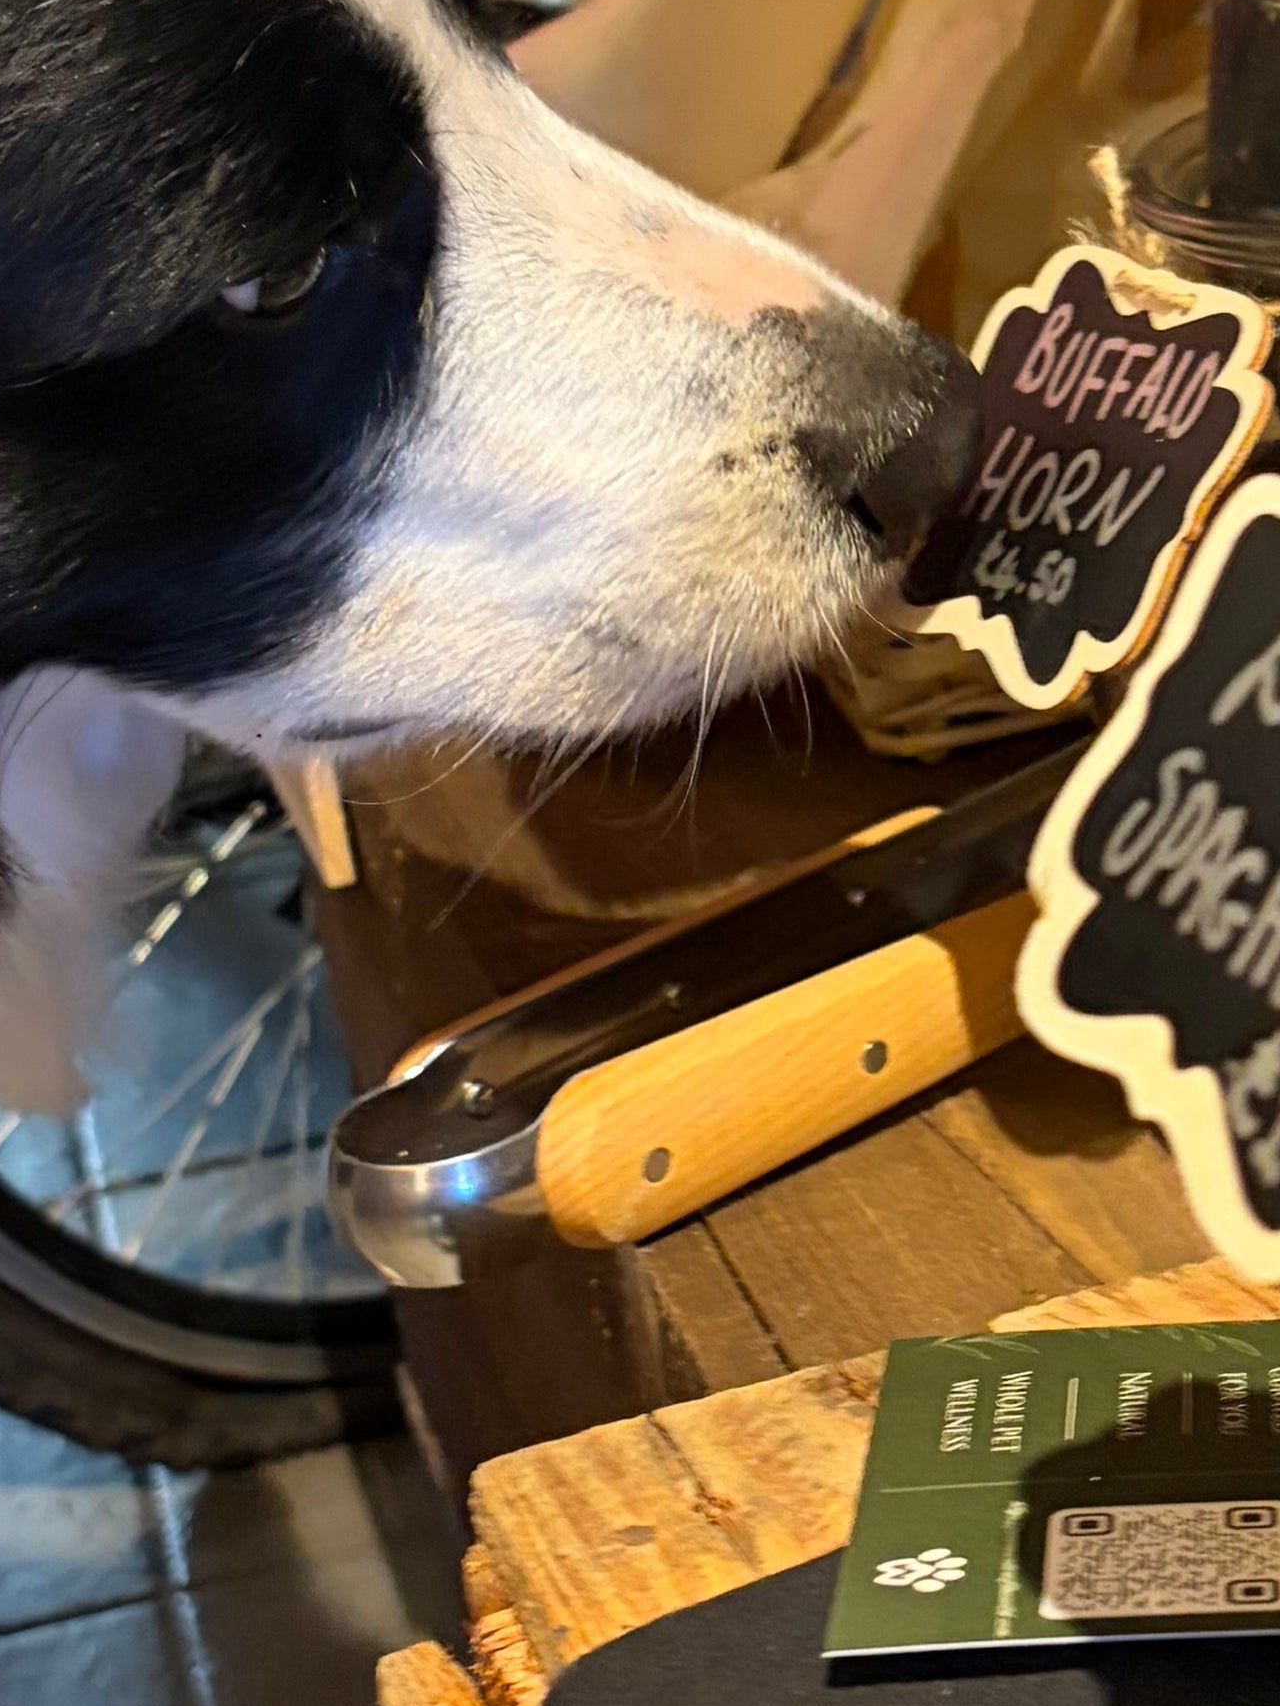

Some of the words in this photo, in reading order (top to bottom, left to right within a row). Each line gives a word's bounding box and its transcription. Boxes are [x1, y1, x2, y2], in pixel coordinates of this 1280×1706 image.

[1013, 302, 1220, 439] BUFFALO
[963, 425, 1166, 547] HORN
[939, 1378, 980, 1453] WELLNESS
[992, 1370, 1034, 1426] WHOLE
[1116, 1371, 1153, 1441] NATURAL
[989, 1426, 1024, 1454] PET
